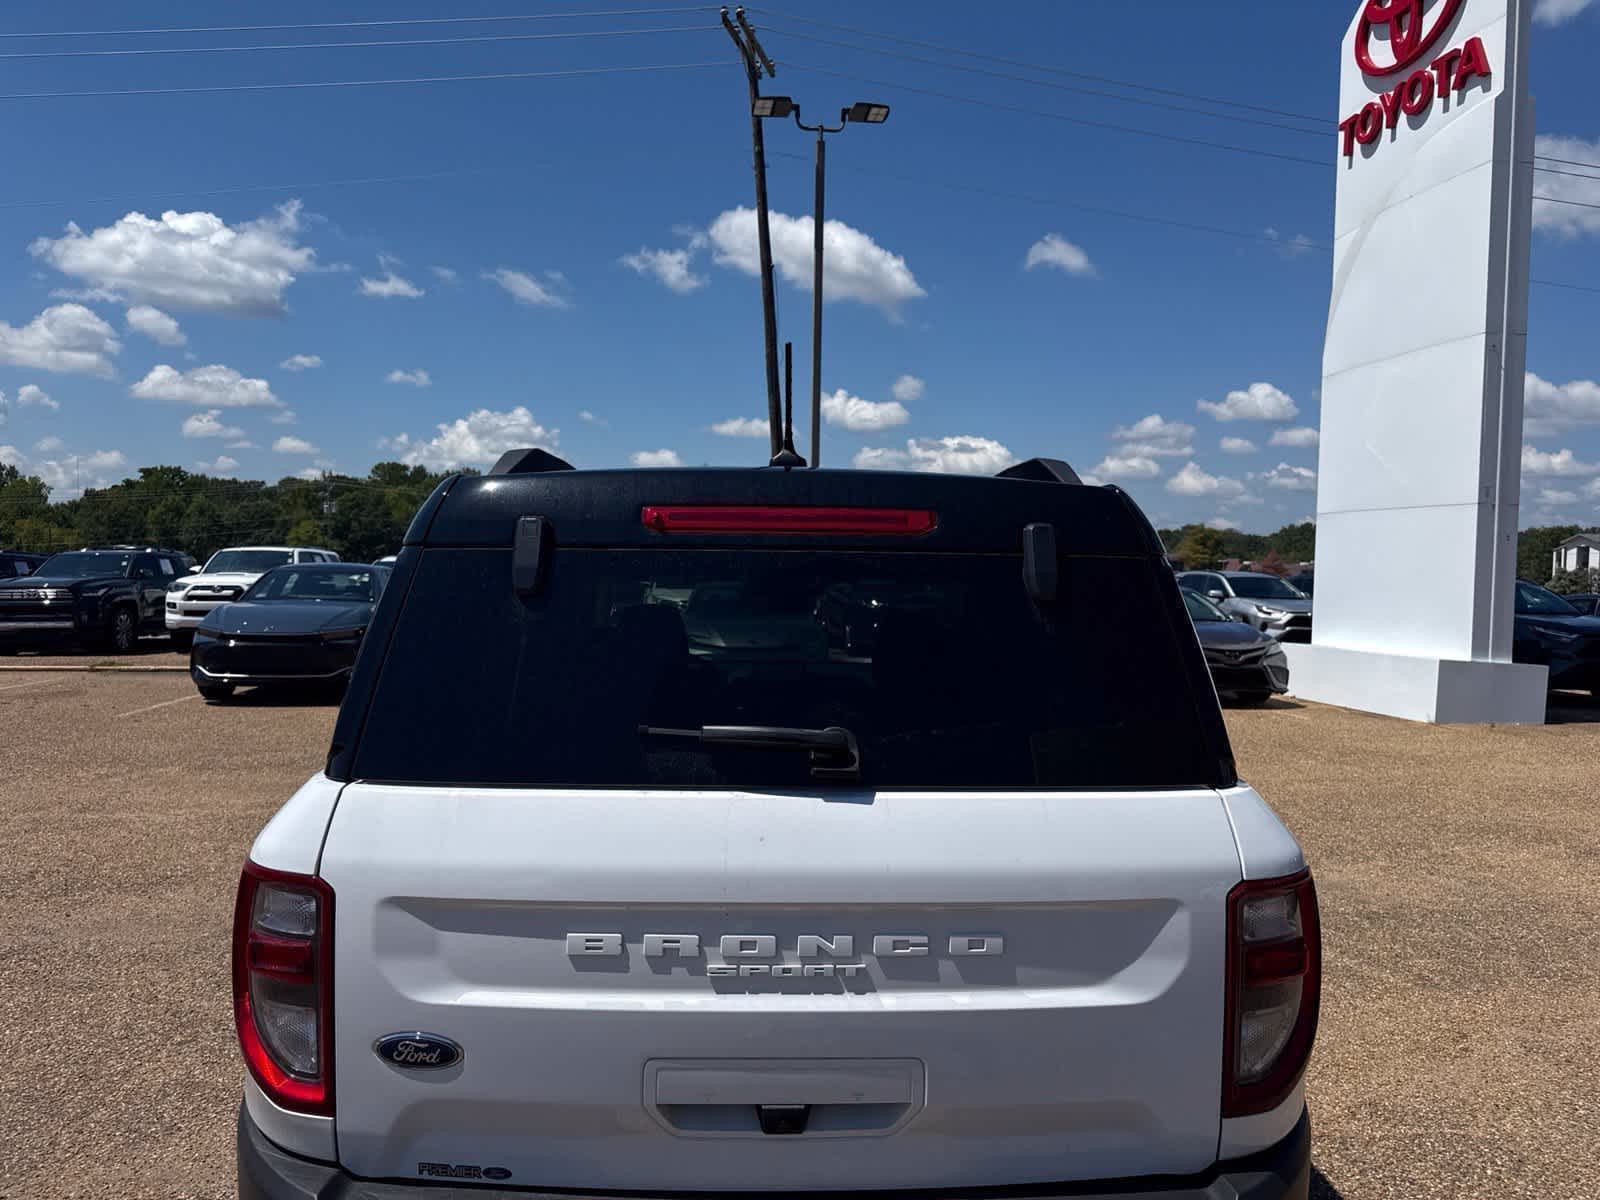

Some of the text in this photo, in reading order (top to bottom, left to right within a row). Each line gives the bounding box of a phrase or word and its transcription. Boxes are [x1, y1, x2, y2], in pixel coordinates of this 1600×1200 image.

[1339, 37, 1491, 157] TOYOTA
[566, 933, 1003, 957] BRONCO
[706, 964, 867, 977] SPORT
[393, 1040, 441, 1063] Ford
[417, 1162, 482, 1178] PREMIER
